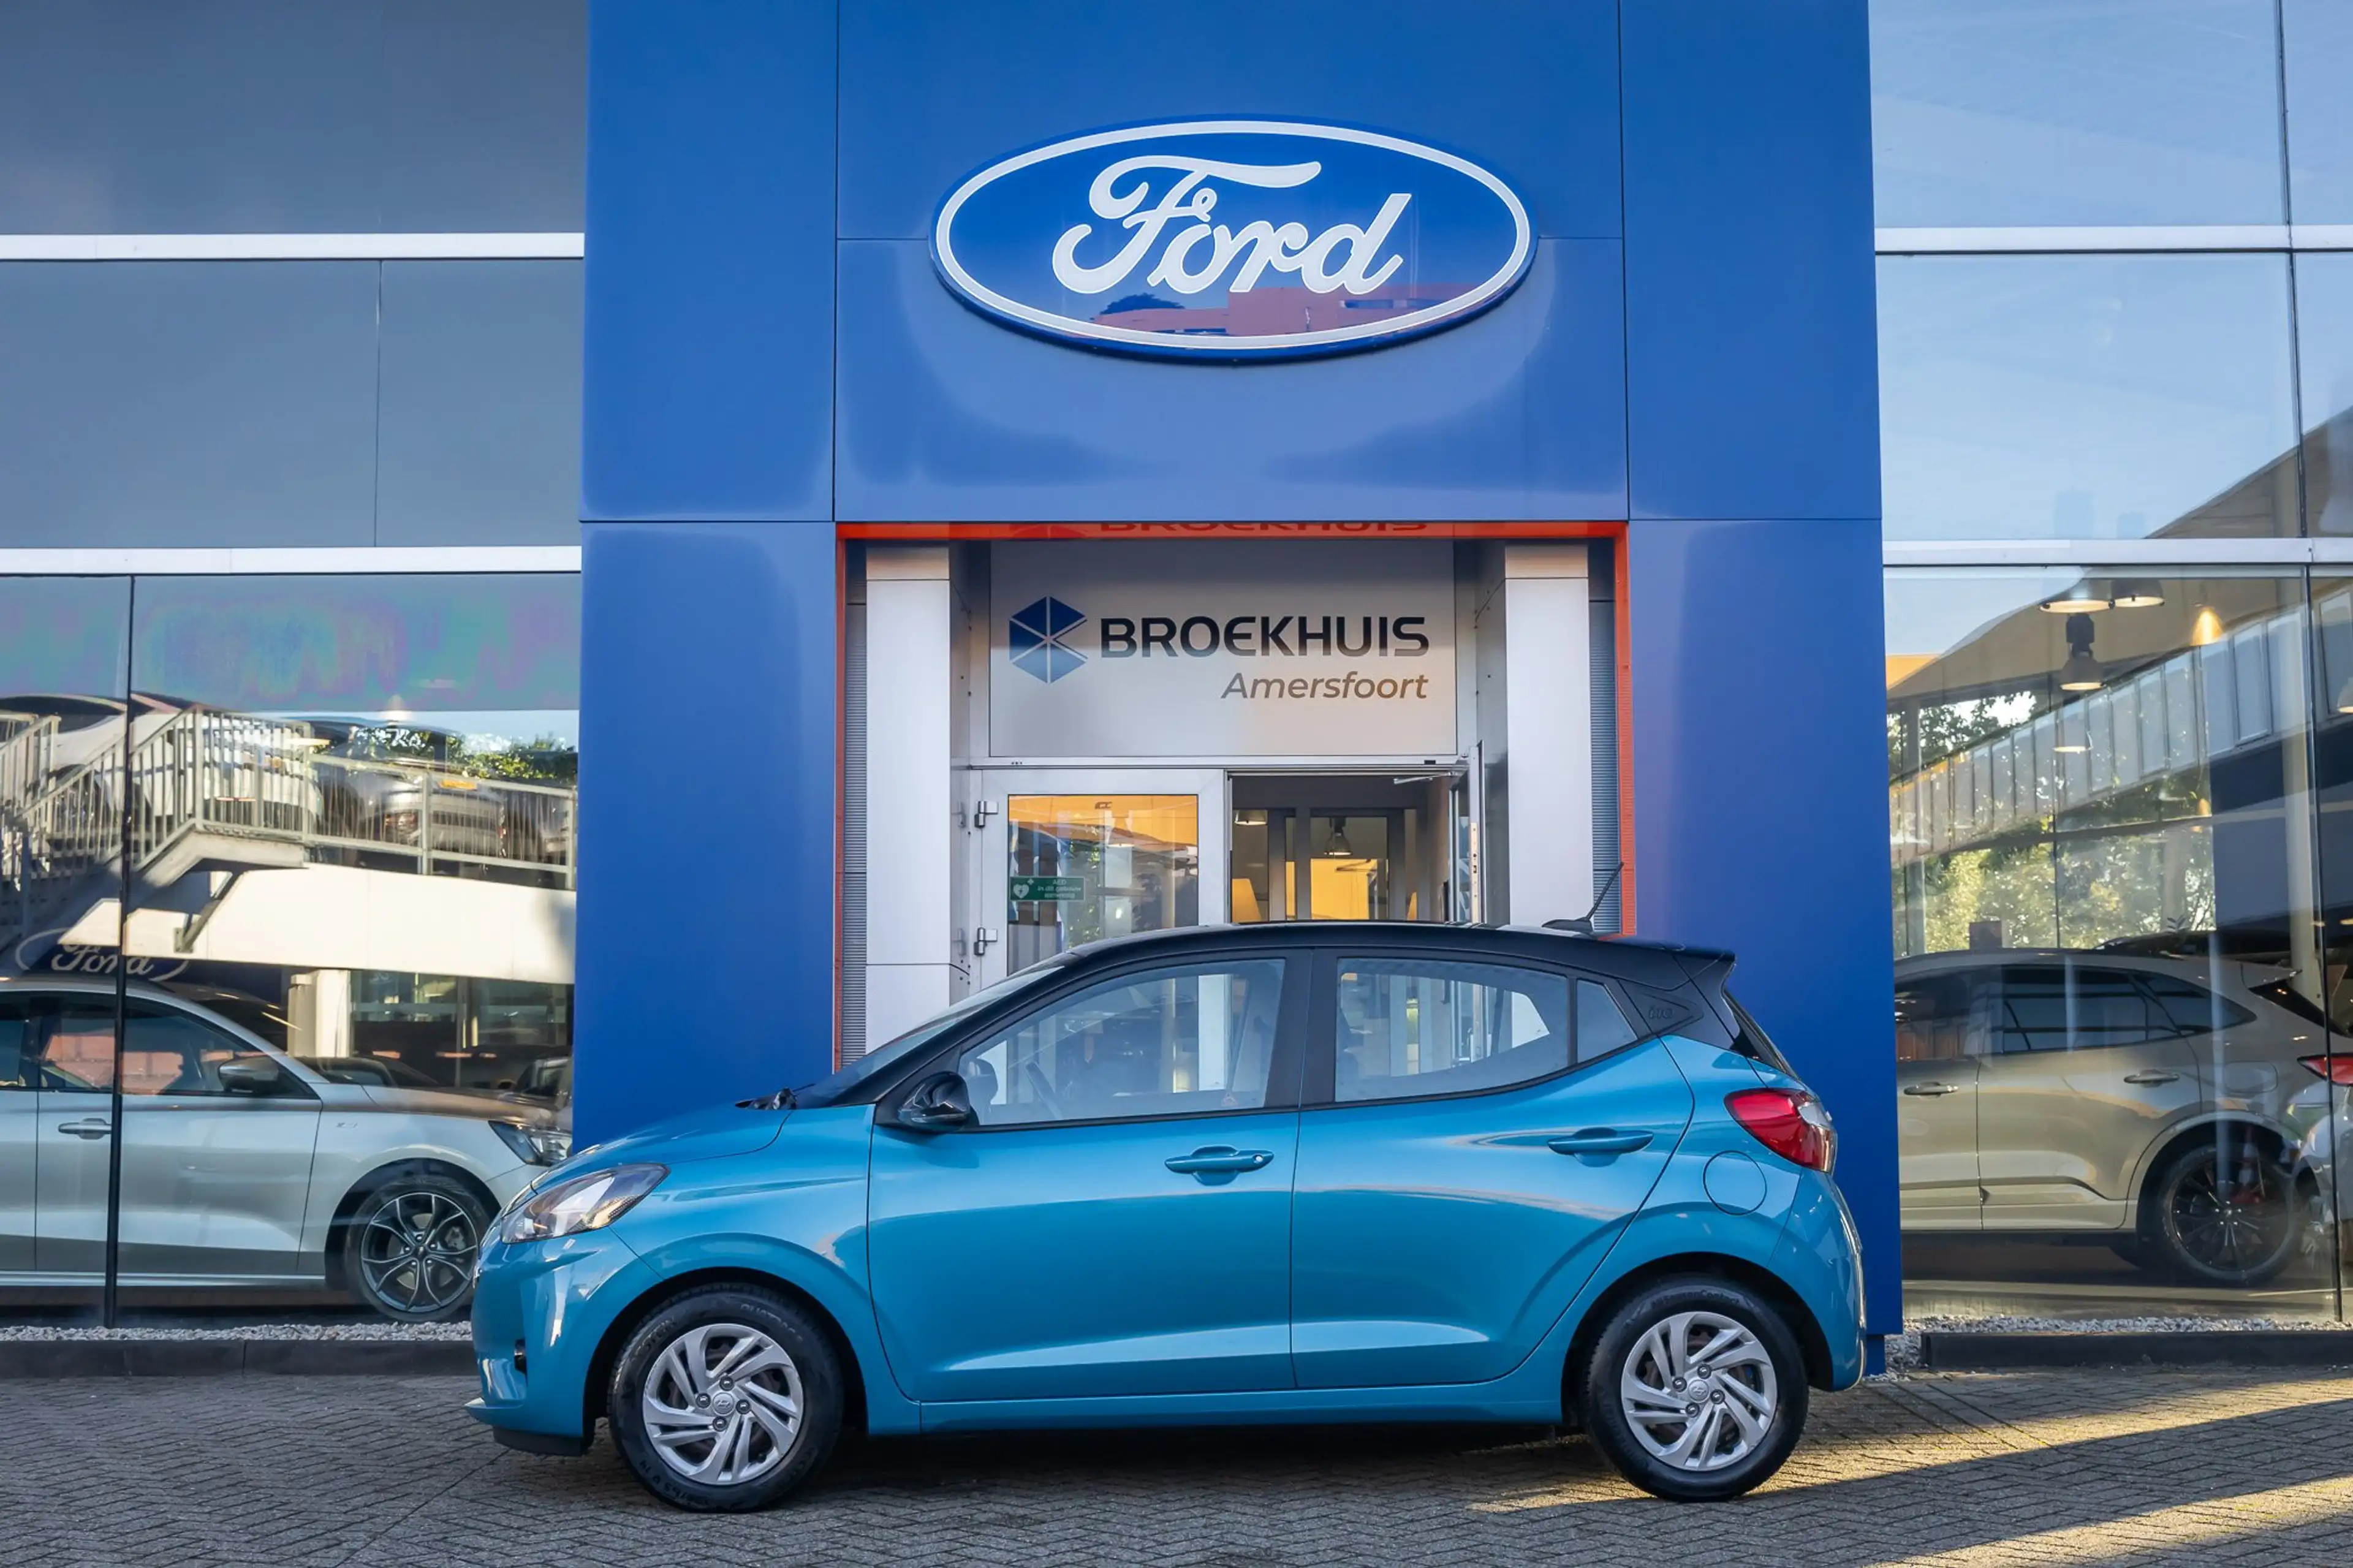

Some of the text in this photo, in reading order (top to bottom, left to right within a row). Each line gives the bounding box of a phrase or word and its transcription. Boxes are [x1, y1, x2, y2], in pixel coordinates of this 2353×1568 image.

[1053, 155, 1411, 294] Ford
[1101, 616, 1429, 658] BROEKHUIS
[1221, 671, 1429, 700] Amersfoort
